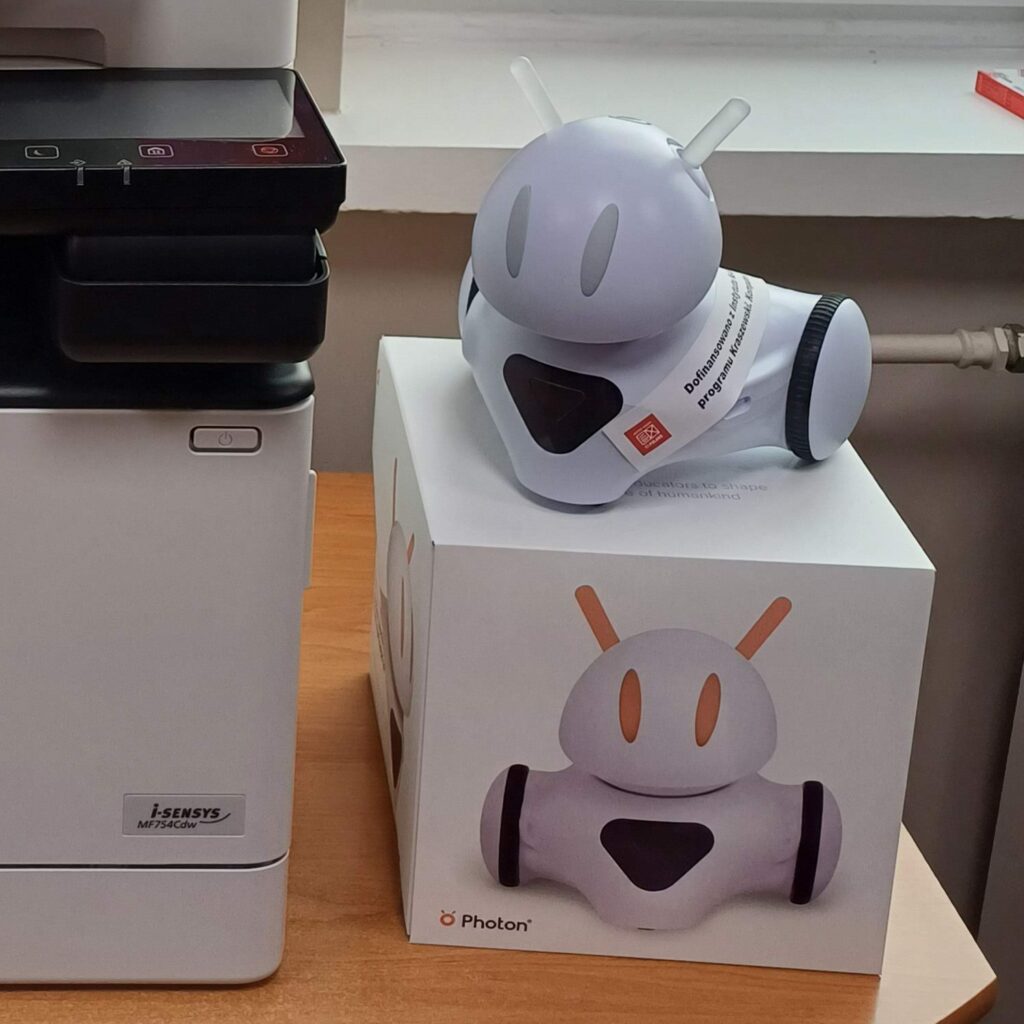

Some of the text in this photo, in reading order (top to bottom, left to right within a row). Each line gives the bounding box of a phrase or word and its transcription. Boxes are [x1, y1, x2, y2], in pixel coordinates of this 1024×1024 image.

[683, 317, 733, 395] Dofinansowano
[697, 356, 734, 410] programu
[720, 482, 769, 492] shape
[150, 803, 222, 819] i-SENSYS
[136, 819, 198, 830] MF754Cdw
[461, 914, 529, 932] Photon
